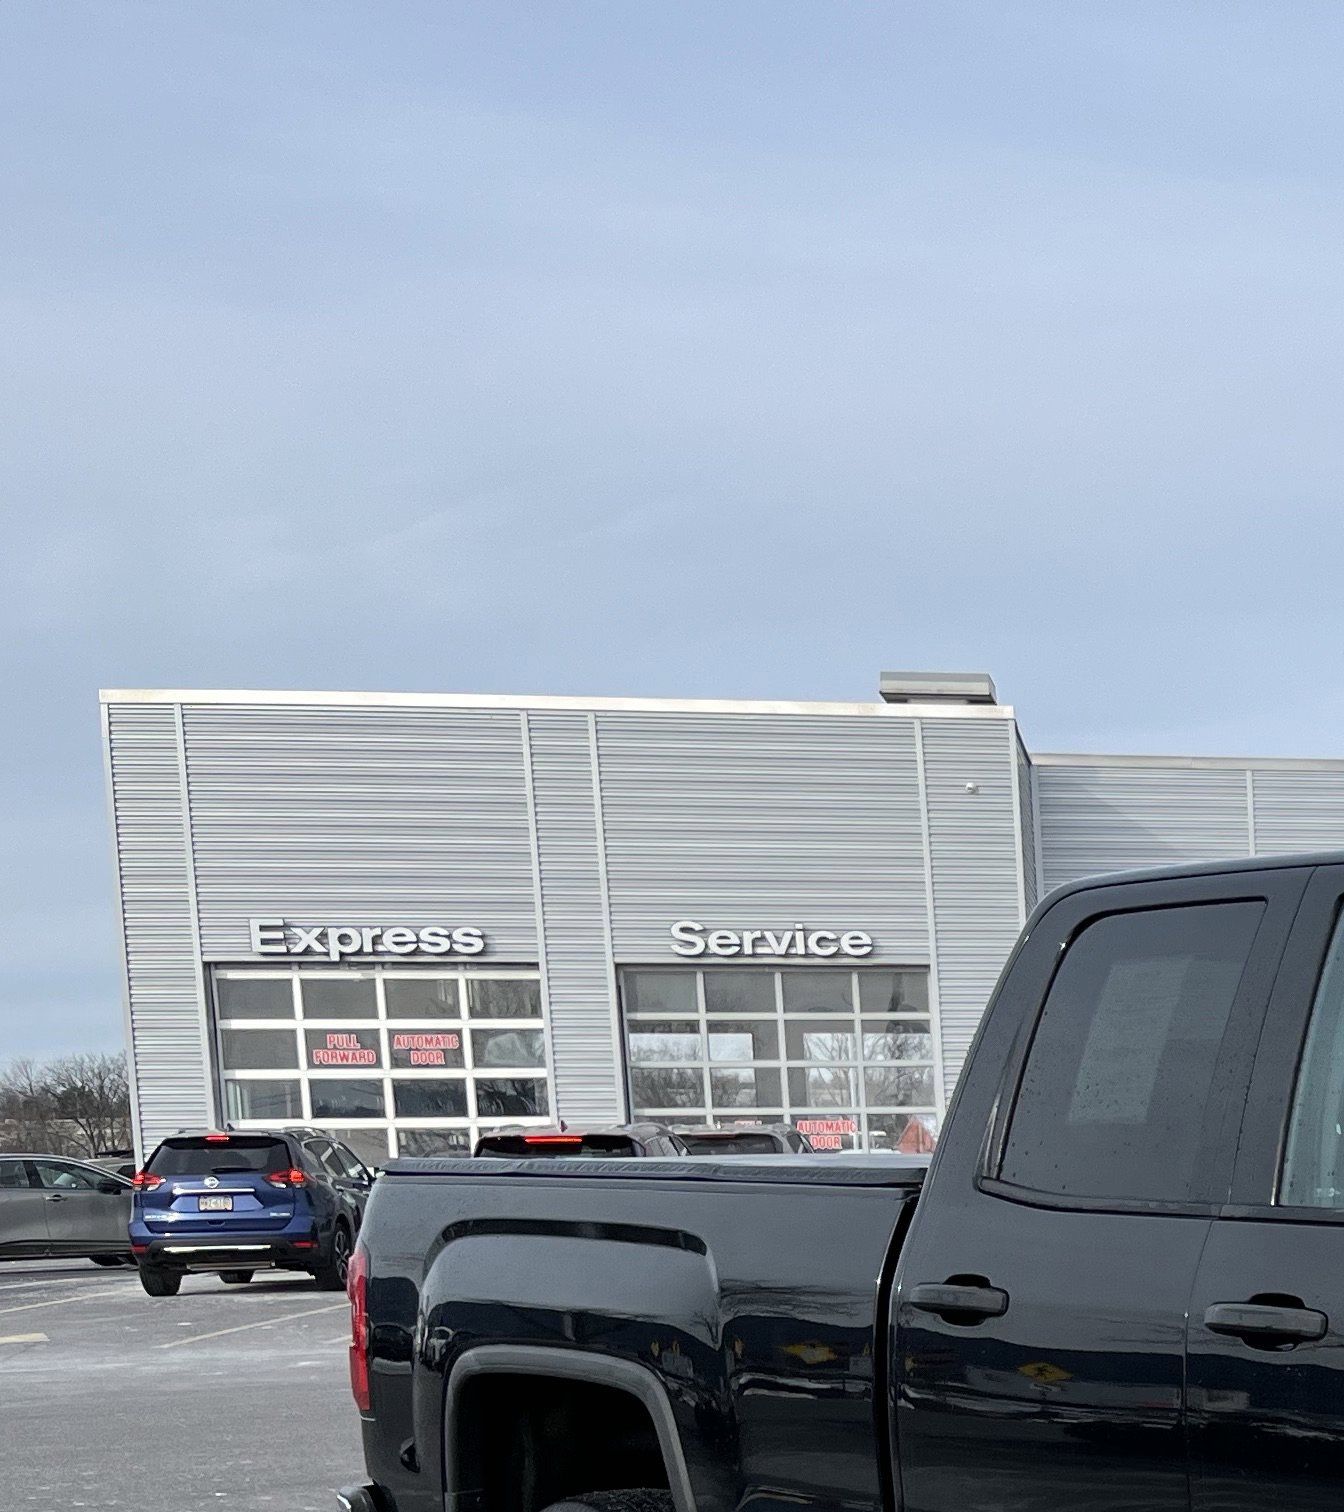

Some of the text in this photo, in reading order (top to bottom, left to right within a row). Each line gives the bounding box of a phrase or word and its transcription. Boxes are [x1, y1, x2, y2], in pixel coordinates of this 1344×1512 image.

[249, 917, 486, 962] Express
[670, 920, 874, 957] Service
[326, 1033, 361, 1049] PULL
[394, 1034, 460, 1050] AUTOMATIC
[313, 1050, 377, 1065] FORWARD
[410, 1051, 446, 1066] DOOR
[797, 1120, 857, 1135] AUTOMATIC
[810, 1135, 842, 1149] DOOR
